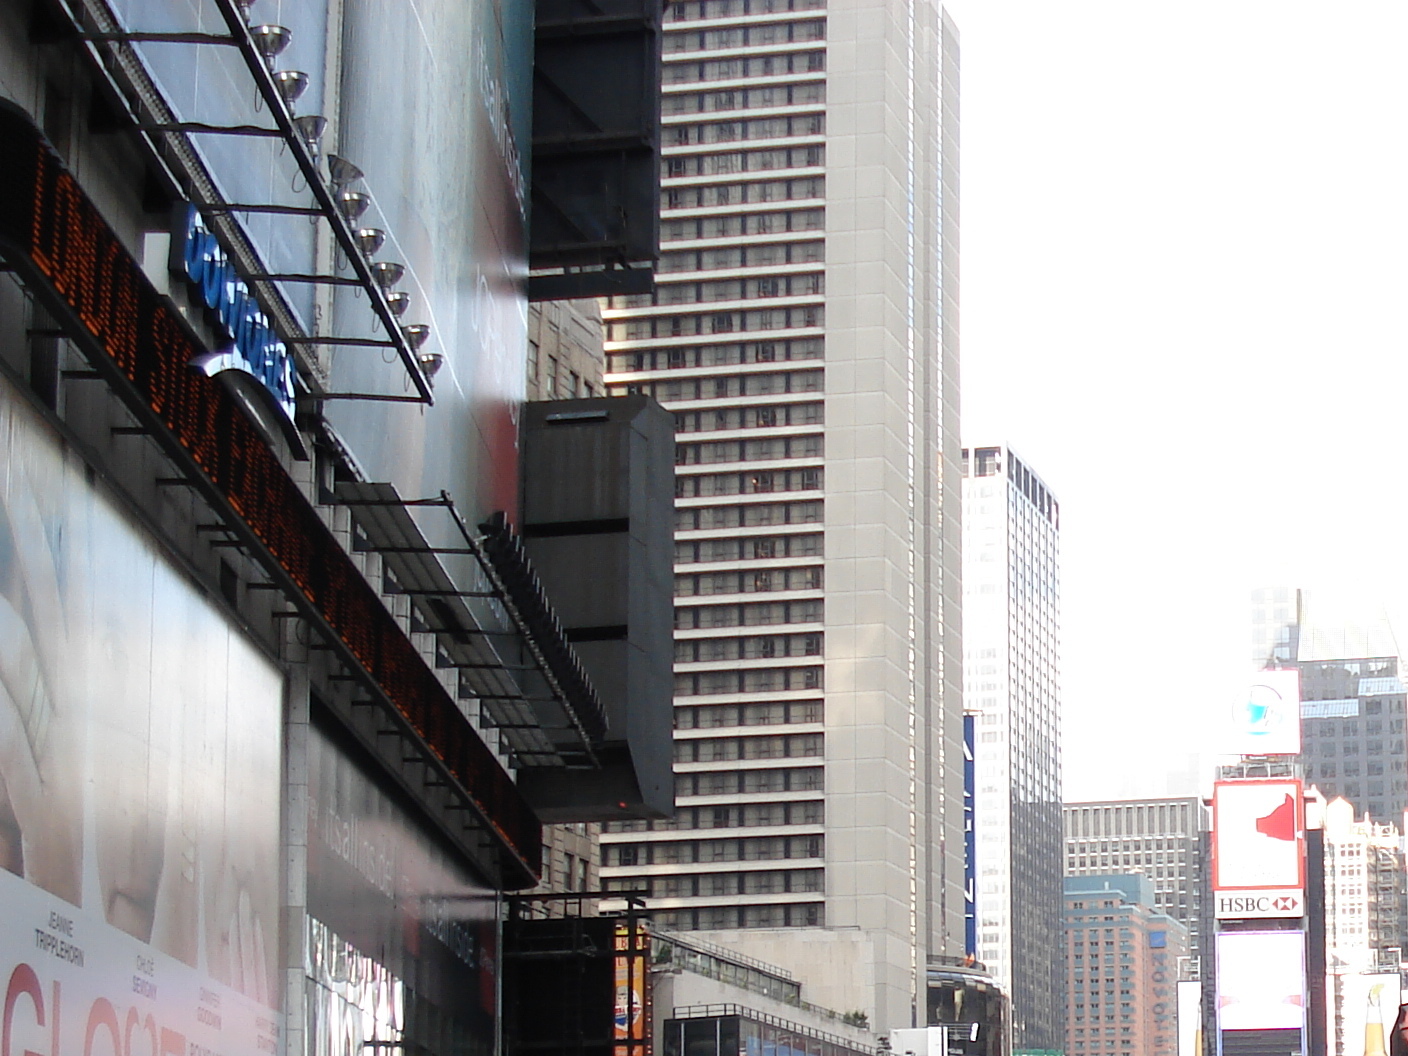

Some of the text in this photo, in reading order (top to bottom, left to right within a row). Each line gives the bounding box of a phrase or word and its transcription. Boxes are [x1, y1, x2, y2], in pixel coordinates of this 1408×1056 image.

[1219, 896, 1269, 913] HSBC
[48, 911, 73, 938] JEANNE
[35, 928, 84, 968] TRIPPLEHORN
